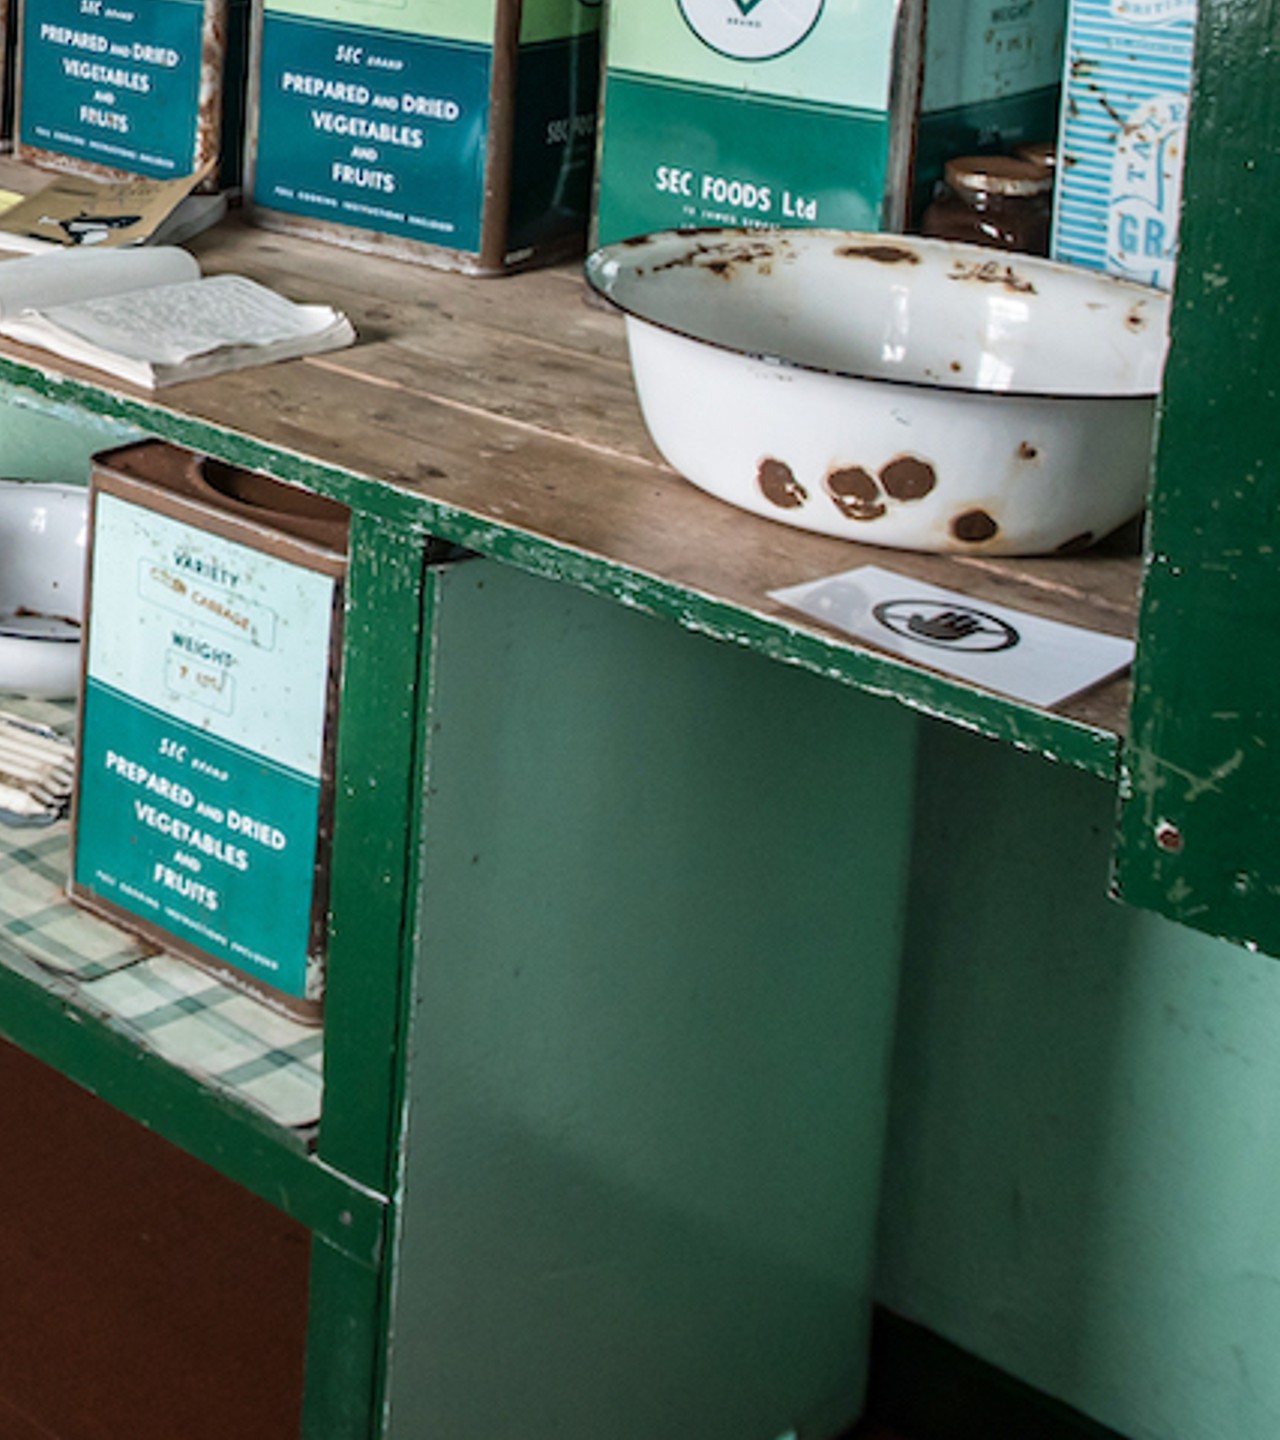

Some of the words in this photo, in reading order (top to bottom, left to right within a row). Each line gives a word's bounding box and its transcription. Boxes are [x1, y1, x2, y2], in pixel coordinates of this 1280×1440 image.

[41, 24, 108, 52] PREPARED
[109, 44, 131, 58] AND
[133, 43, 179, 67] DRIED
[335, 44, 363, 64] SEC
[62, 57, 150, 93] VEGETABLES
[94, 91, 116, 105] AND
[282, 72, 370, 104] PREPARED
[371, 95, 399, 111] AND
[401, 93, 460, 121] DRIED
[79, 106, 129, 133] FRUITS
[311, 110, 423, 148] VEGETABLES
[350, 145, 378, 162] AND
[1127, 102, 1184, 183] TATE
[331, 162, 396, 193] FRUITS
[656, 166, 693, 197] SEC
[702, 175, 771, 212] FOODS
[782, 191, 817, 220] Ltd
[1119, 213, 1165, 259] GR
[173, 551, 239, 588] VARIETY
[172, 630, 231, 667] WEIGHT
[158, 737, 188, 763] SEC
[105, 750, 195, 809] PREPARED
[196, 801, 225, 824] AND
[227, 808, 287, 851] DRIED
[134, 800, 249, 871] VEGETABLES
[173, 850, 202, 872] AND
[154, 863, 219, 912] FRUITS
